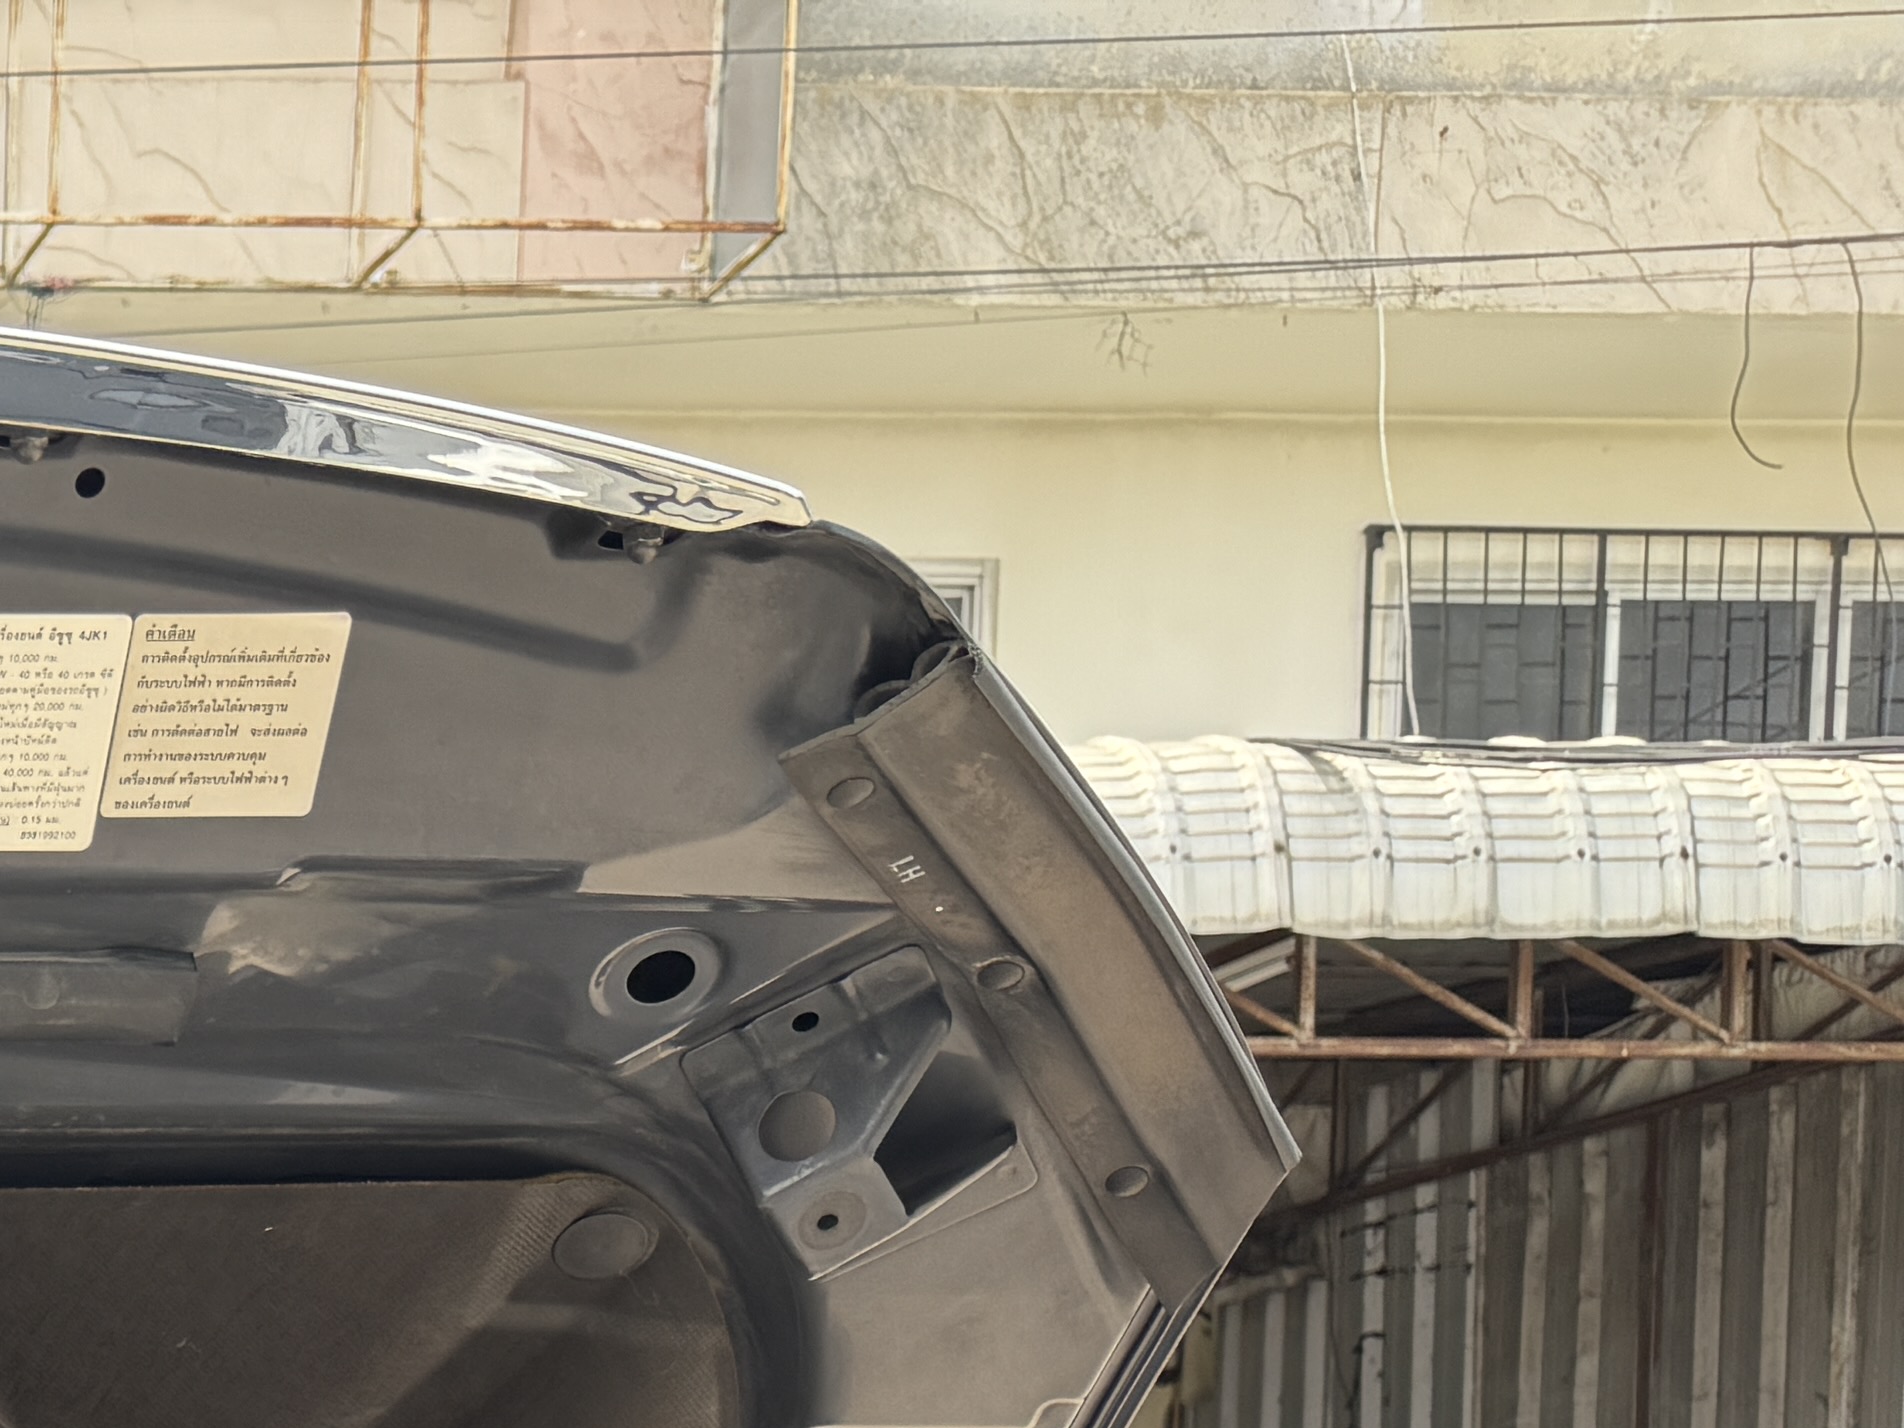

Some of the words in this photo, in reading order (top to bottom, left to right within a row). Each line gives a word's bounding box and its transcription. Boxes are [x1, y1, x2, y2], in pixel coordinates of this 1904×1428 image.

[78, 630, 108, 640] 4JK1
[145, 623, 195, 642] คำเตือน
[889, 855, 926, 884] LH
